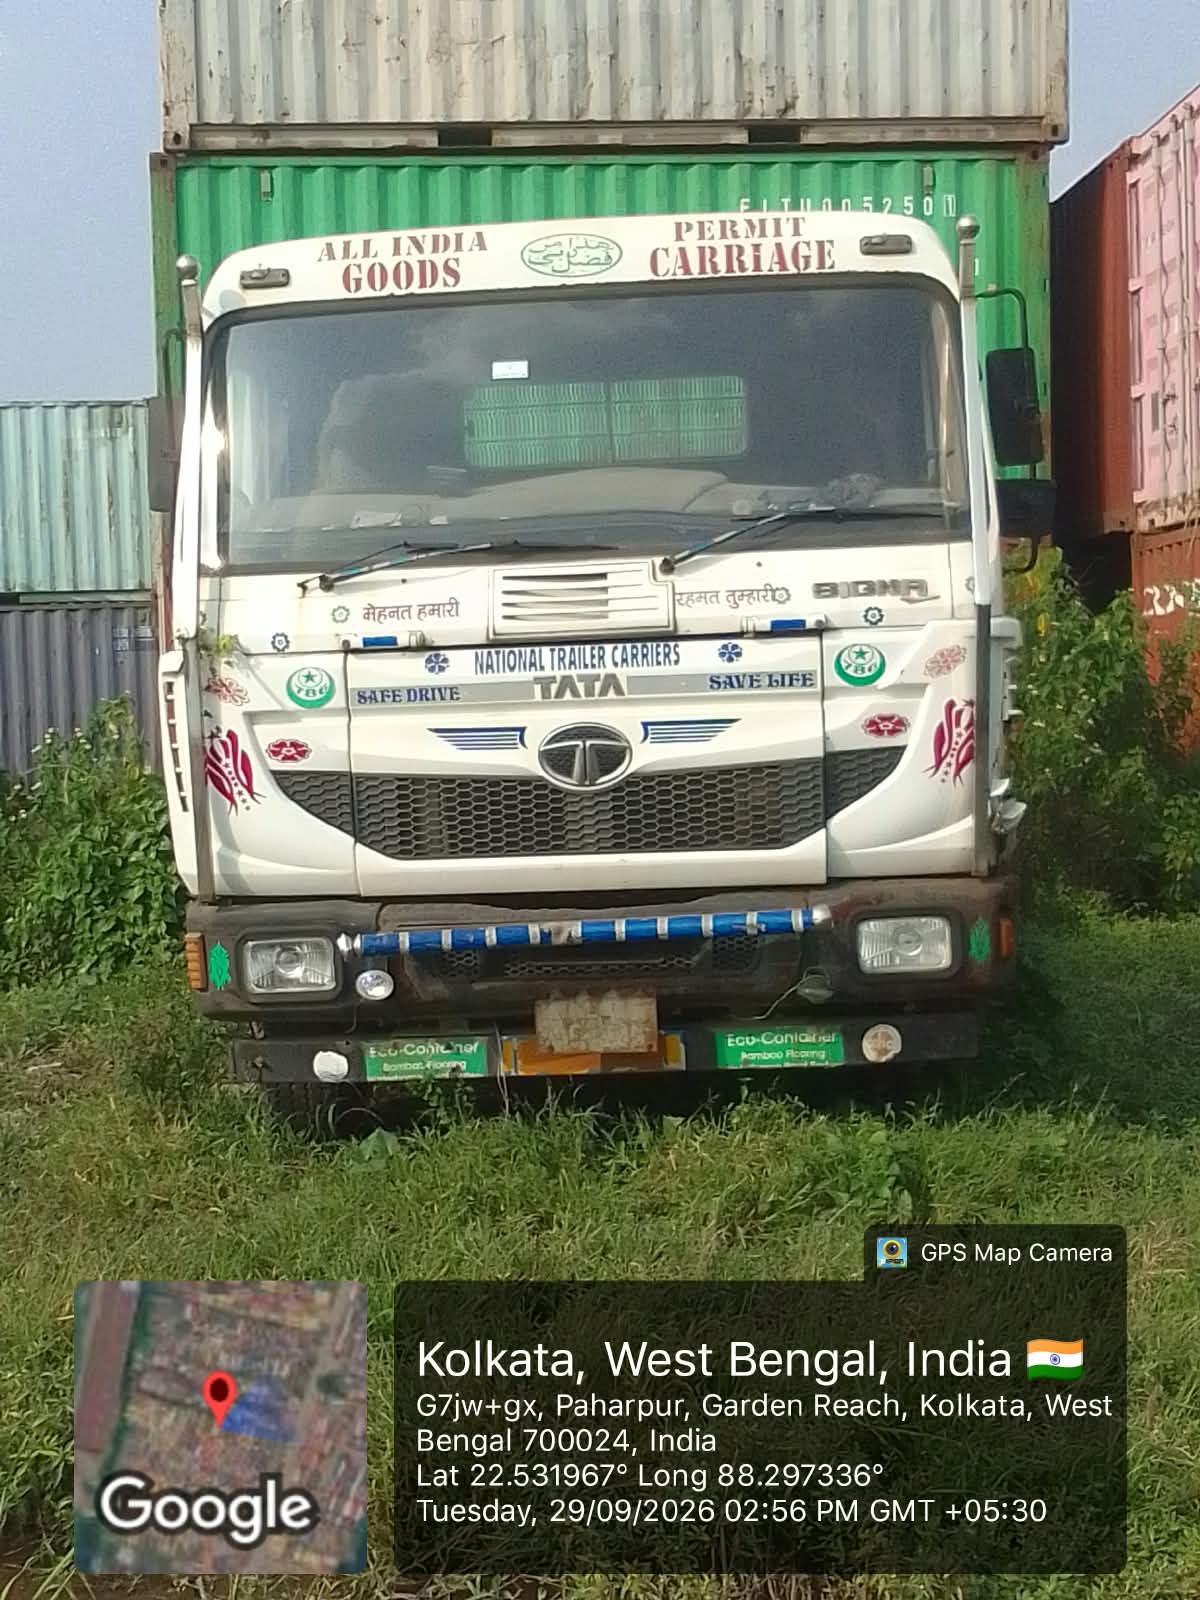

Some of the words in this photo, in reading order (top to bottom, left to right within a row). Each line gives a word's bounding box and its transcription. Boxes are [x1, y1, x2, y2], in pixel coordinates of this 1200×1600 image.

[673, 216, 807, 242] PERMIT
[317, 236, 379, 262] ALL
[391, 231, 488, 257] INDIA
[649, 239, 836, 278] CARRIAGE
[341, 257, 462, 294] GOODS
[362, 603, 413, 624] मेहनत
[416, 596, 460, 621] हमारी
[674, 591, 720, 608] रहमत
[474, 647, 545, 675] NATIONAL
[549, 644, 606, 672] TRAILER
[611, 642, 680, 669] CARRIERS
[357, 687, 403, 705] SAFE
[406, 685, 461, 702] DRIVE
[534, 673, 626, 700] TATA
[709, 674, 762, 691] SAVE
[767, 672, 815, 689] LIFE
